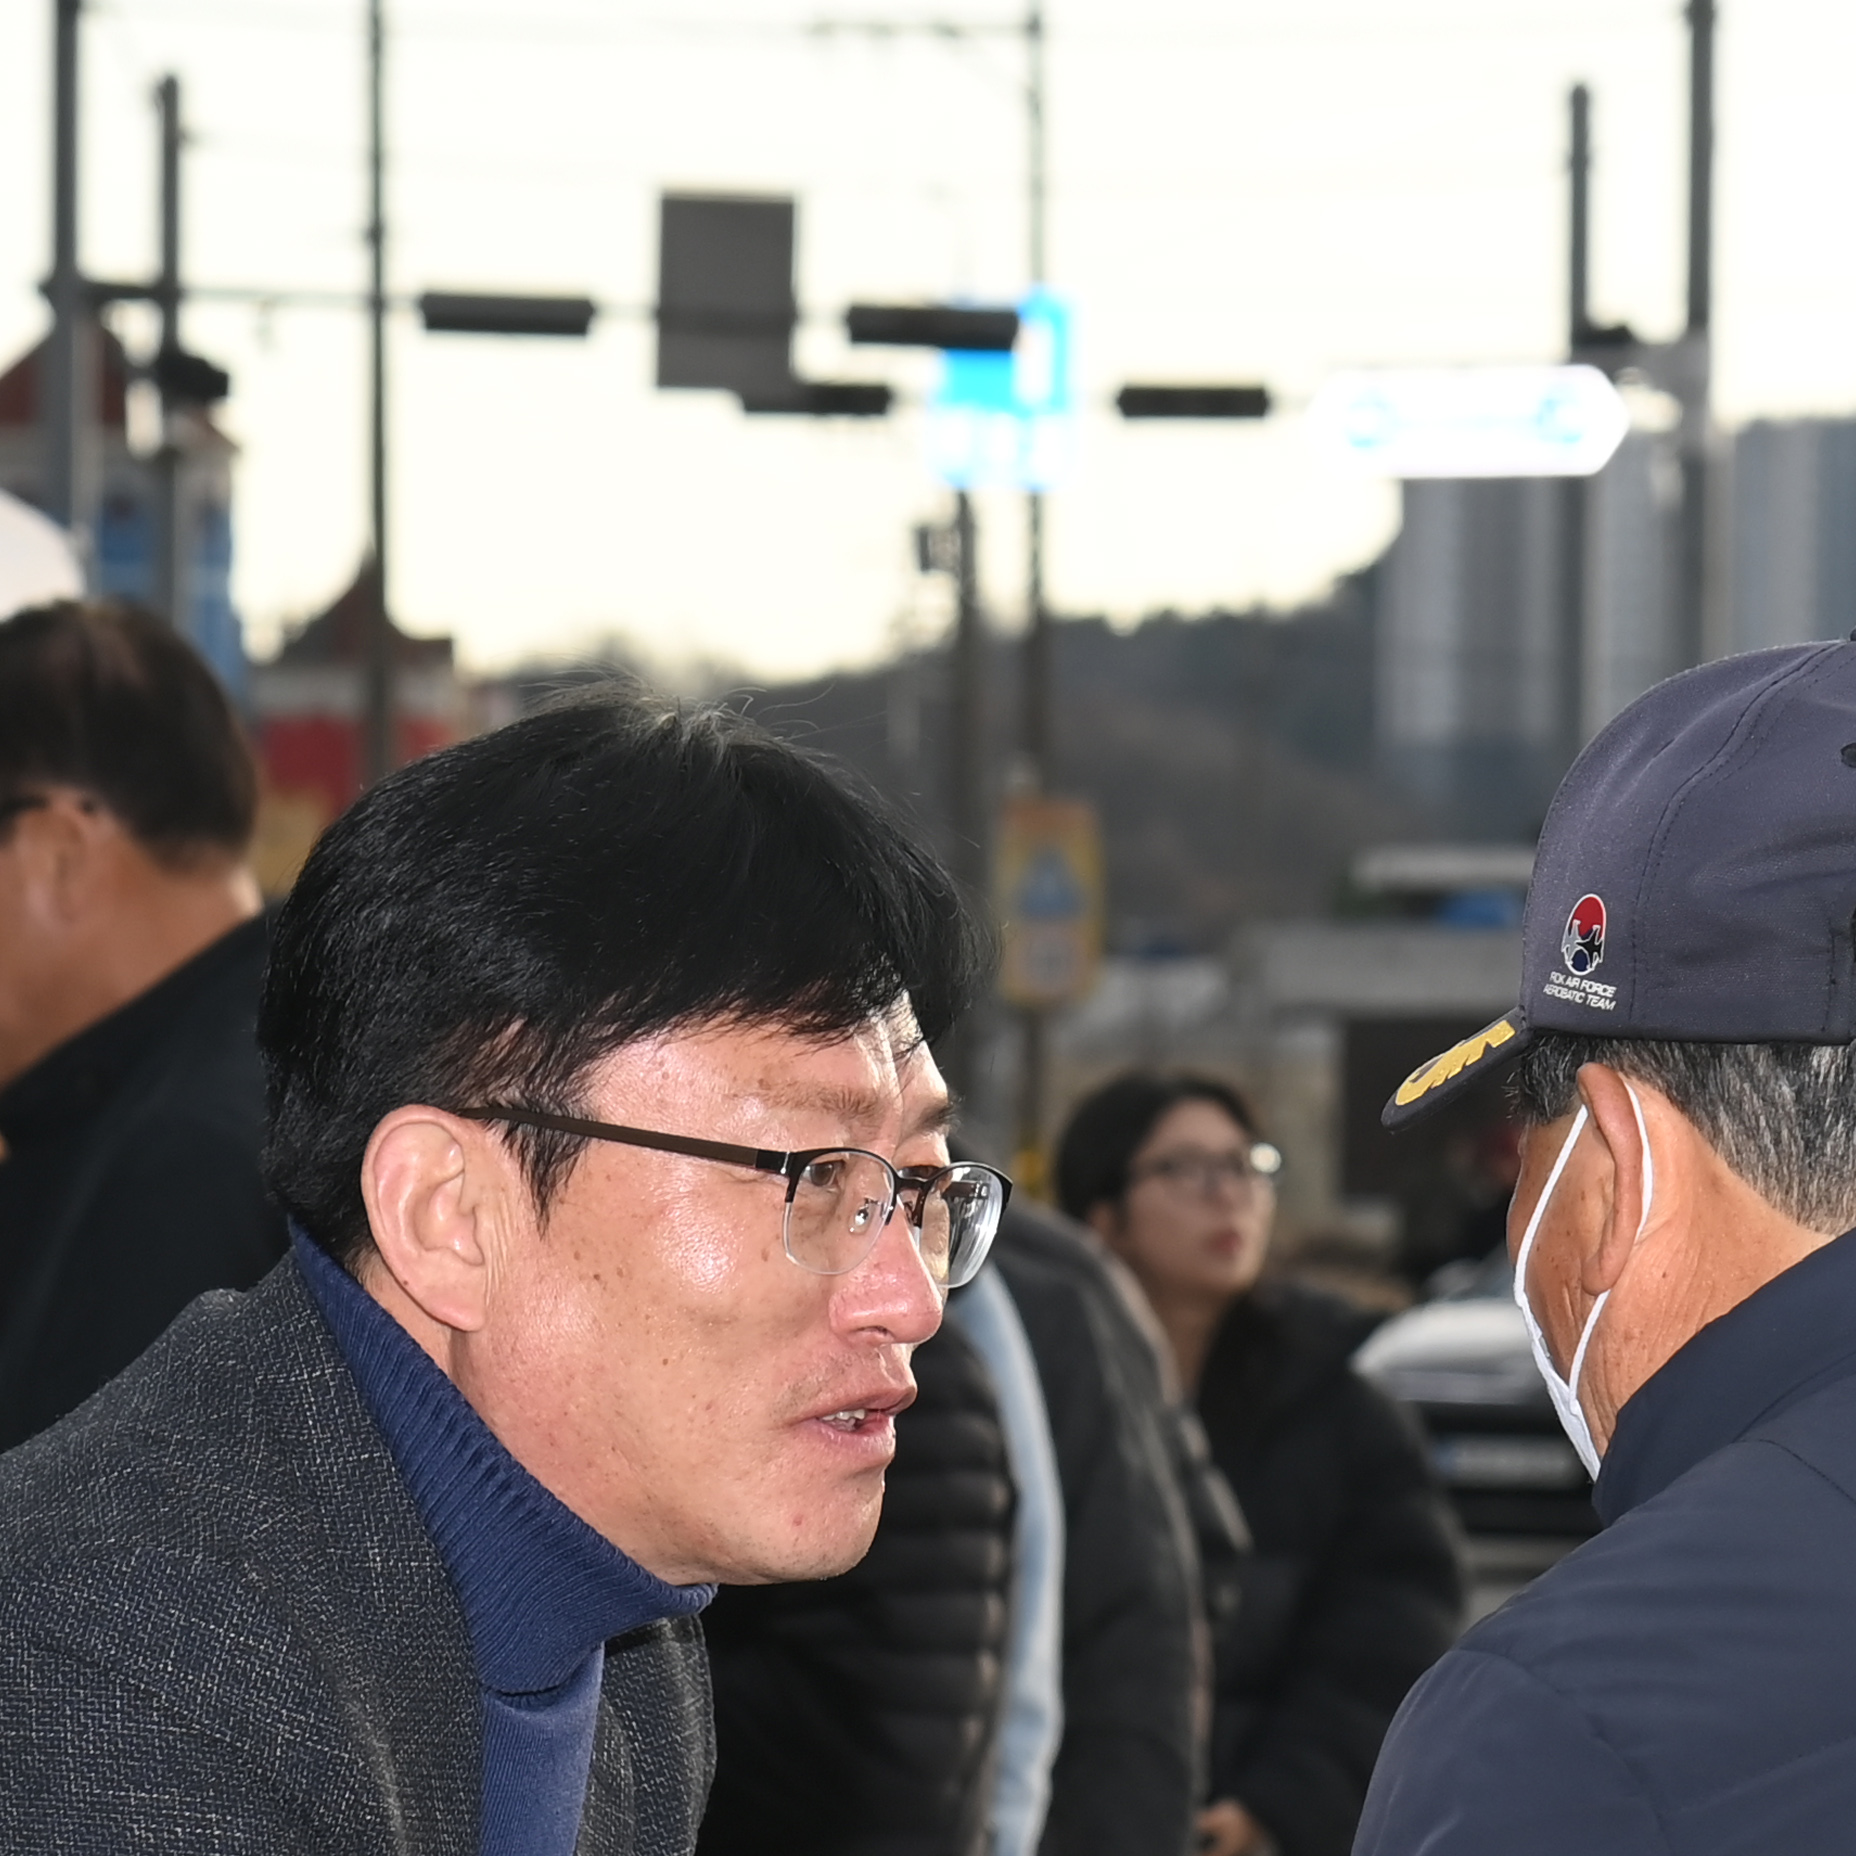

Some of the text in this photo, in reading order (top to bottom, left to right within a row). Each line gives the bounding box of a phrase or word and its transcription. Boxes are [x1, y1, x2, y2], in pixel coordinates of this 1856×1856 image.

[1550, 971, 1617, 997] ROK AIR FORCE
[1543, 984, 1617, 1011] AEROBATIC TEAM
